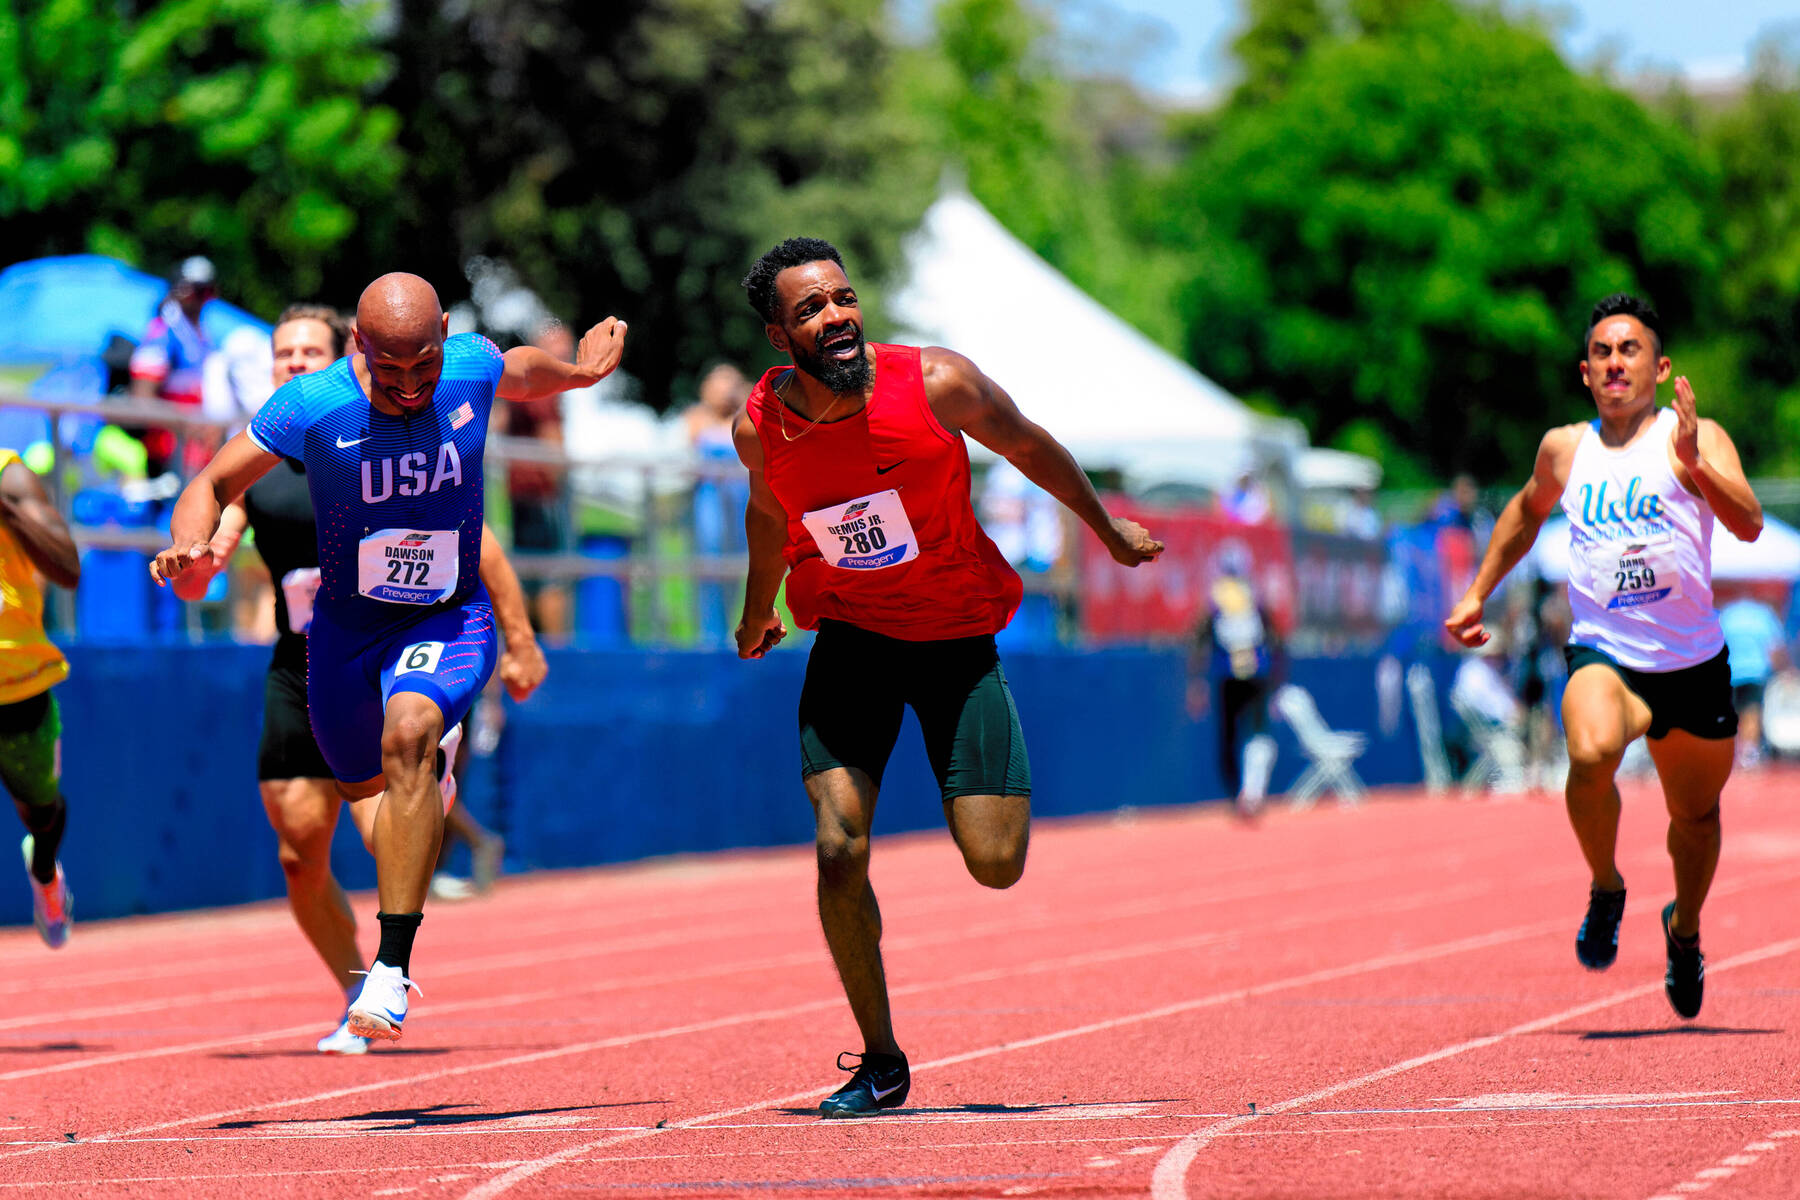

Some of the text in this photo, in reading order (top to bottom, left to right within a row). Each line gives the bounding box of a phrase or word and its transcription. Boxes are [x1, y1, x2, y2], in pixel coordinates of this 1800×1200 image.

[361, 440, 462, 504] USA
[827, 518, 867, 536] DEMUS
[867, 514, 885, 527] JR.
[838, 526, 887, 554] 280
[385, 546, 434, 561] DAWSON
[386, 559, 430, 586] 272
[1614, 568, 1656, 592] 259
[382, 587, 431, 601] Prevagen
[405, 643, 433, 670] 6
